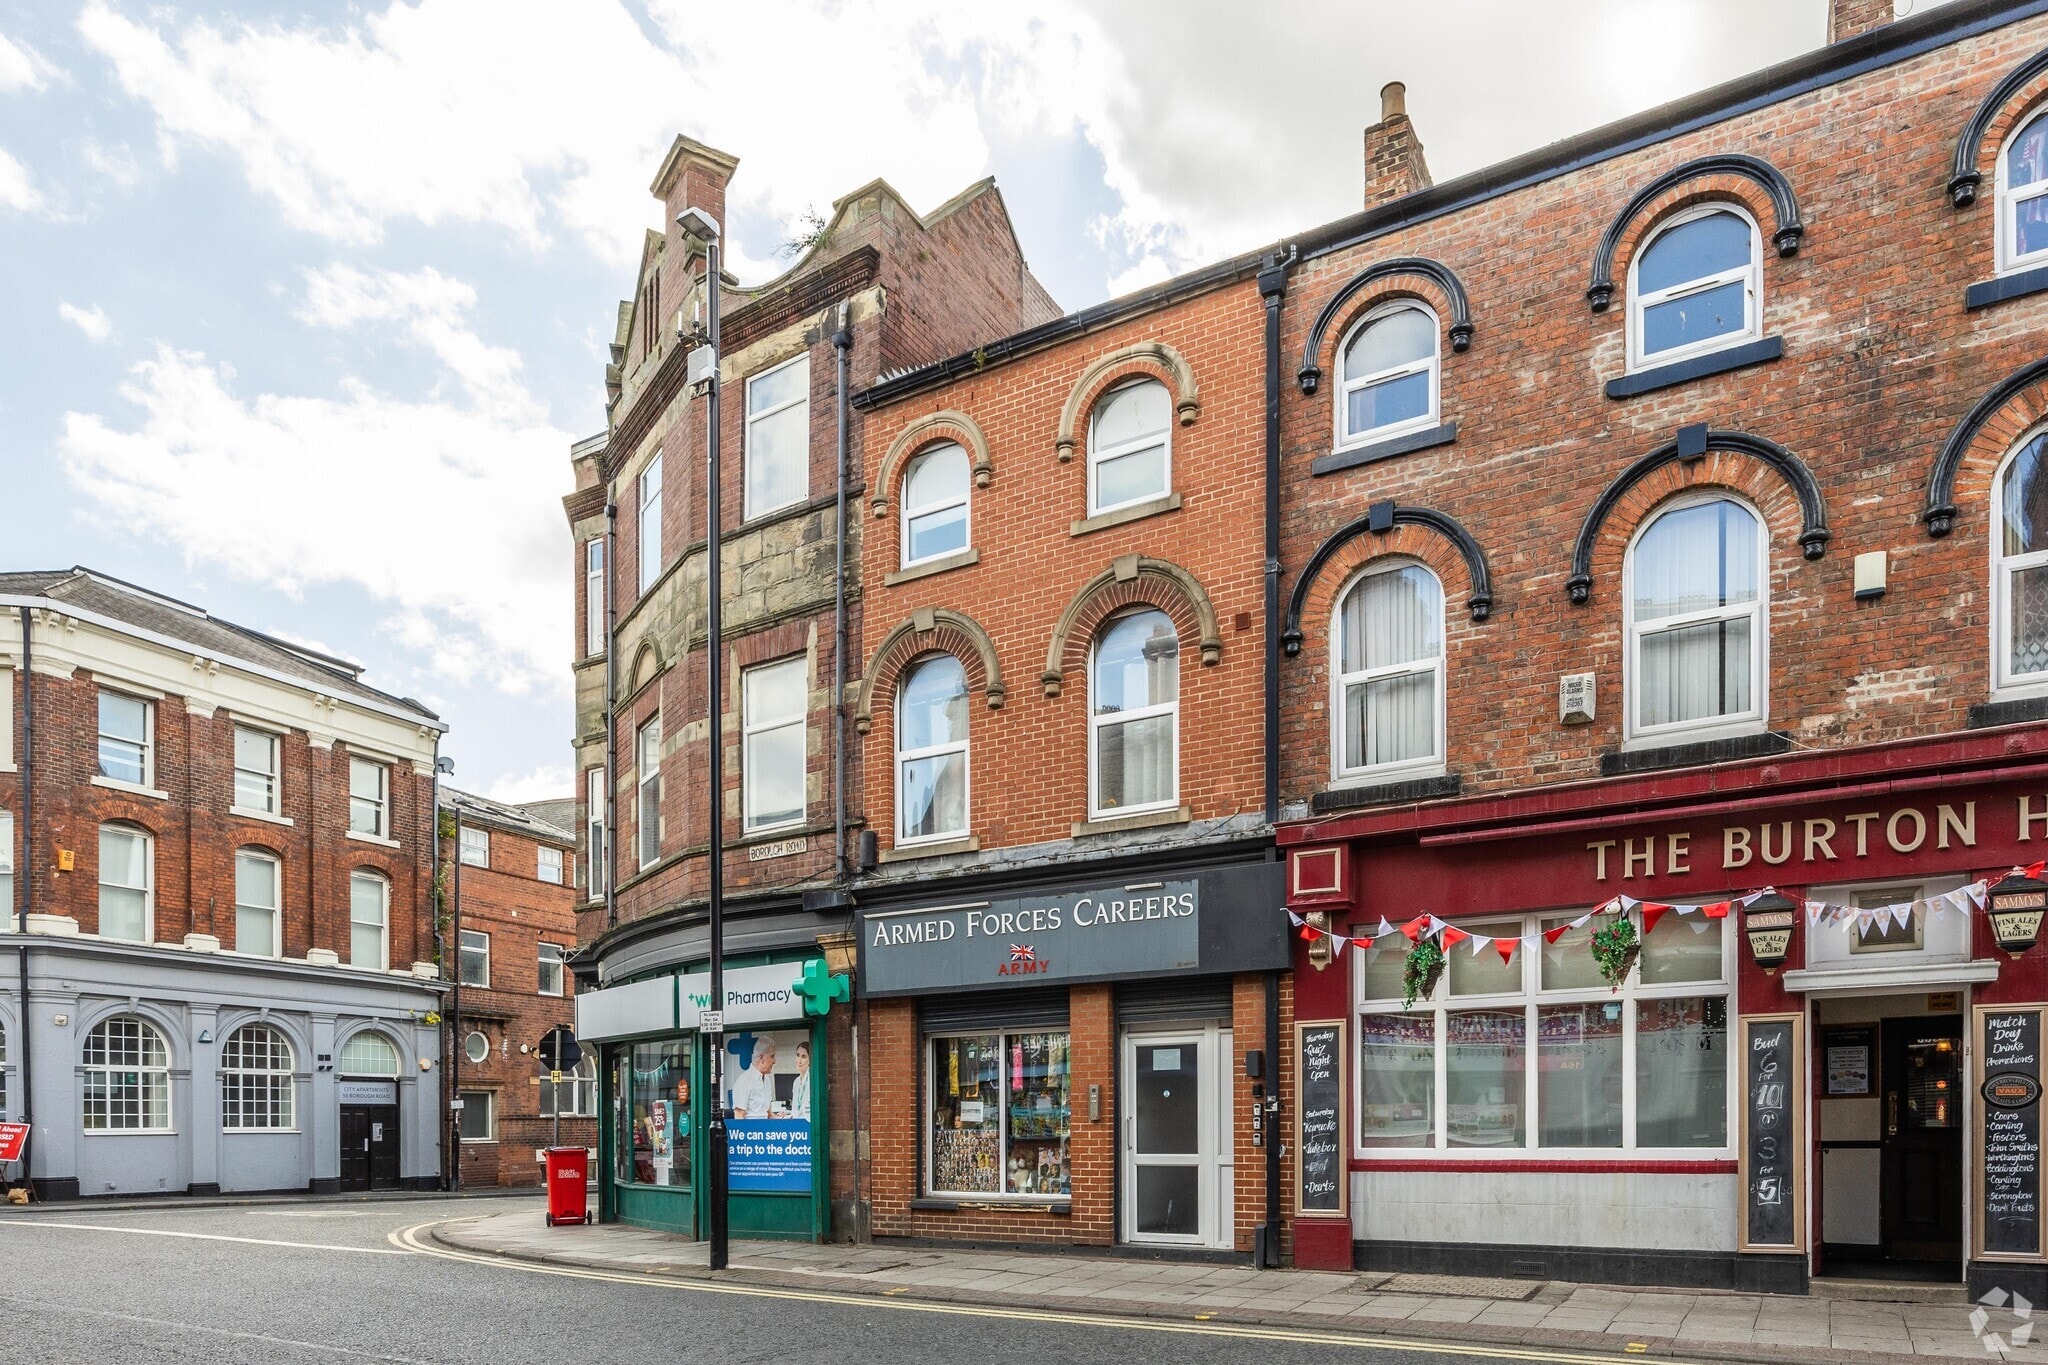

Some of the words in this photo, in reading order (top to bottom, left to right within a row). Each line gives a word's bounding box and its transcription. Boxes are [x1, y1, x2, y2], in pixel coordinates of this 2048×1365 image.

[786, 840, 805, 854] ROAD
[1587, 832, 1690, 880] THE
[1722, 801, 1976, 869] BURTON
[1995, 894, 2043, 909] SAMMY'S
[873, 919, 955, 947] ARMED
[966, 907, 1062, 937] FORCES
[1073, 892, 1194, 927] CAREERS
[1747, 913, 1792, 928] SAMMY'S
[1997, 917, 2016, 927] FINE
[2018, 916, 2039, 925] ALES
[1751, 935, 1768, 945] FINE
[1770, 935, 1788, 943] ALES
[2002, 929, 2032, 938] LAGERS
[998, 959, 1049, 976] ARMY
[727, 989, 791, 1005] Pharmacy
[1988, 1015, 2027, 1030] Match
[1754, 1033, 1781, 1050] Bud
[1994, 1029, 2021, 1042] Day
[1993, 1041, 2024, 1054] Drinks
[1760, 1051, 1778, 1072] 6
[1986, 1054, 2034, 1067] Promotions
[552, 1071, 561, 1081] H
[1306, 1108, 1334, 1119] Saturday
[1993, 1111, 2019, 1121] Coors
[1305, 1120, 1337, 1133] Karaoke
[1989, 1121, 2024, 1134] Carling
[729, 1129, 745, 1140] We
[747, 1131, 763, 1140] can
[765, 1131, 787, 1140] save
[790, 1131, 808, 1142] you
[1992, 1132, 2027, 1141] Fosters
[728, 1146, 735, 1155] a
[736, 1144, 752, 1157] trip
[754, 1145, 765, 1155] to
[767, 1144, 783, 1155] the
[1305, 1141, 1337, 1154] Jukebox
[1758, 1136, 1777, 1160] 3
[1987, 1142, 2007, 1152] John
[2009, 1142, 2038, 1152] Smiths
[1308, 1180, 1335, 1193] Darts
[1990, 1174, 2021, 1188] Carling
[1989, 1190, 2032, 1204] Strongbow
[1988, 1203, 2009, 1212] Dark
